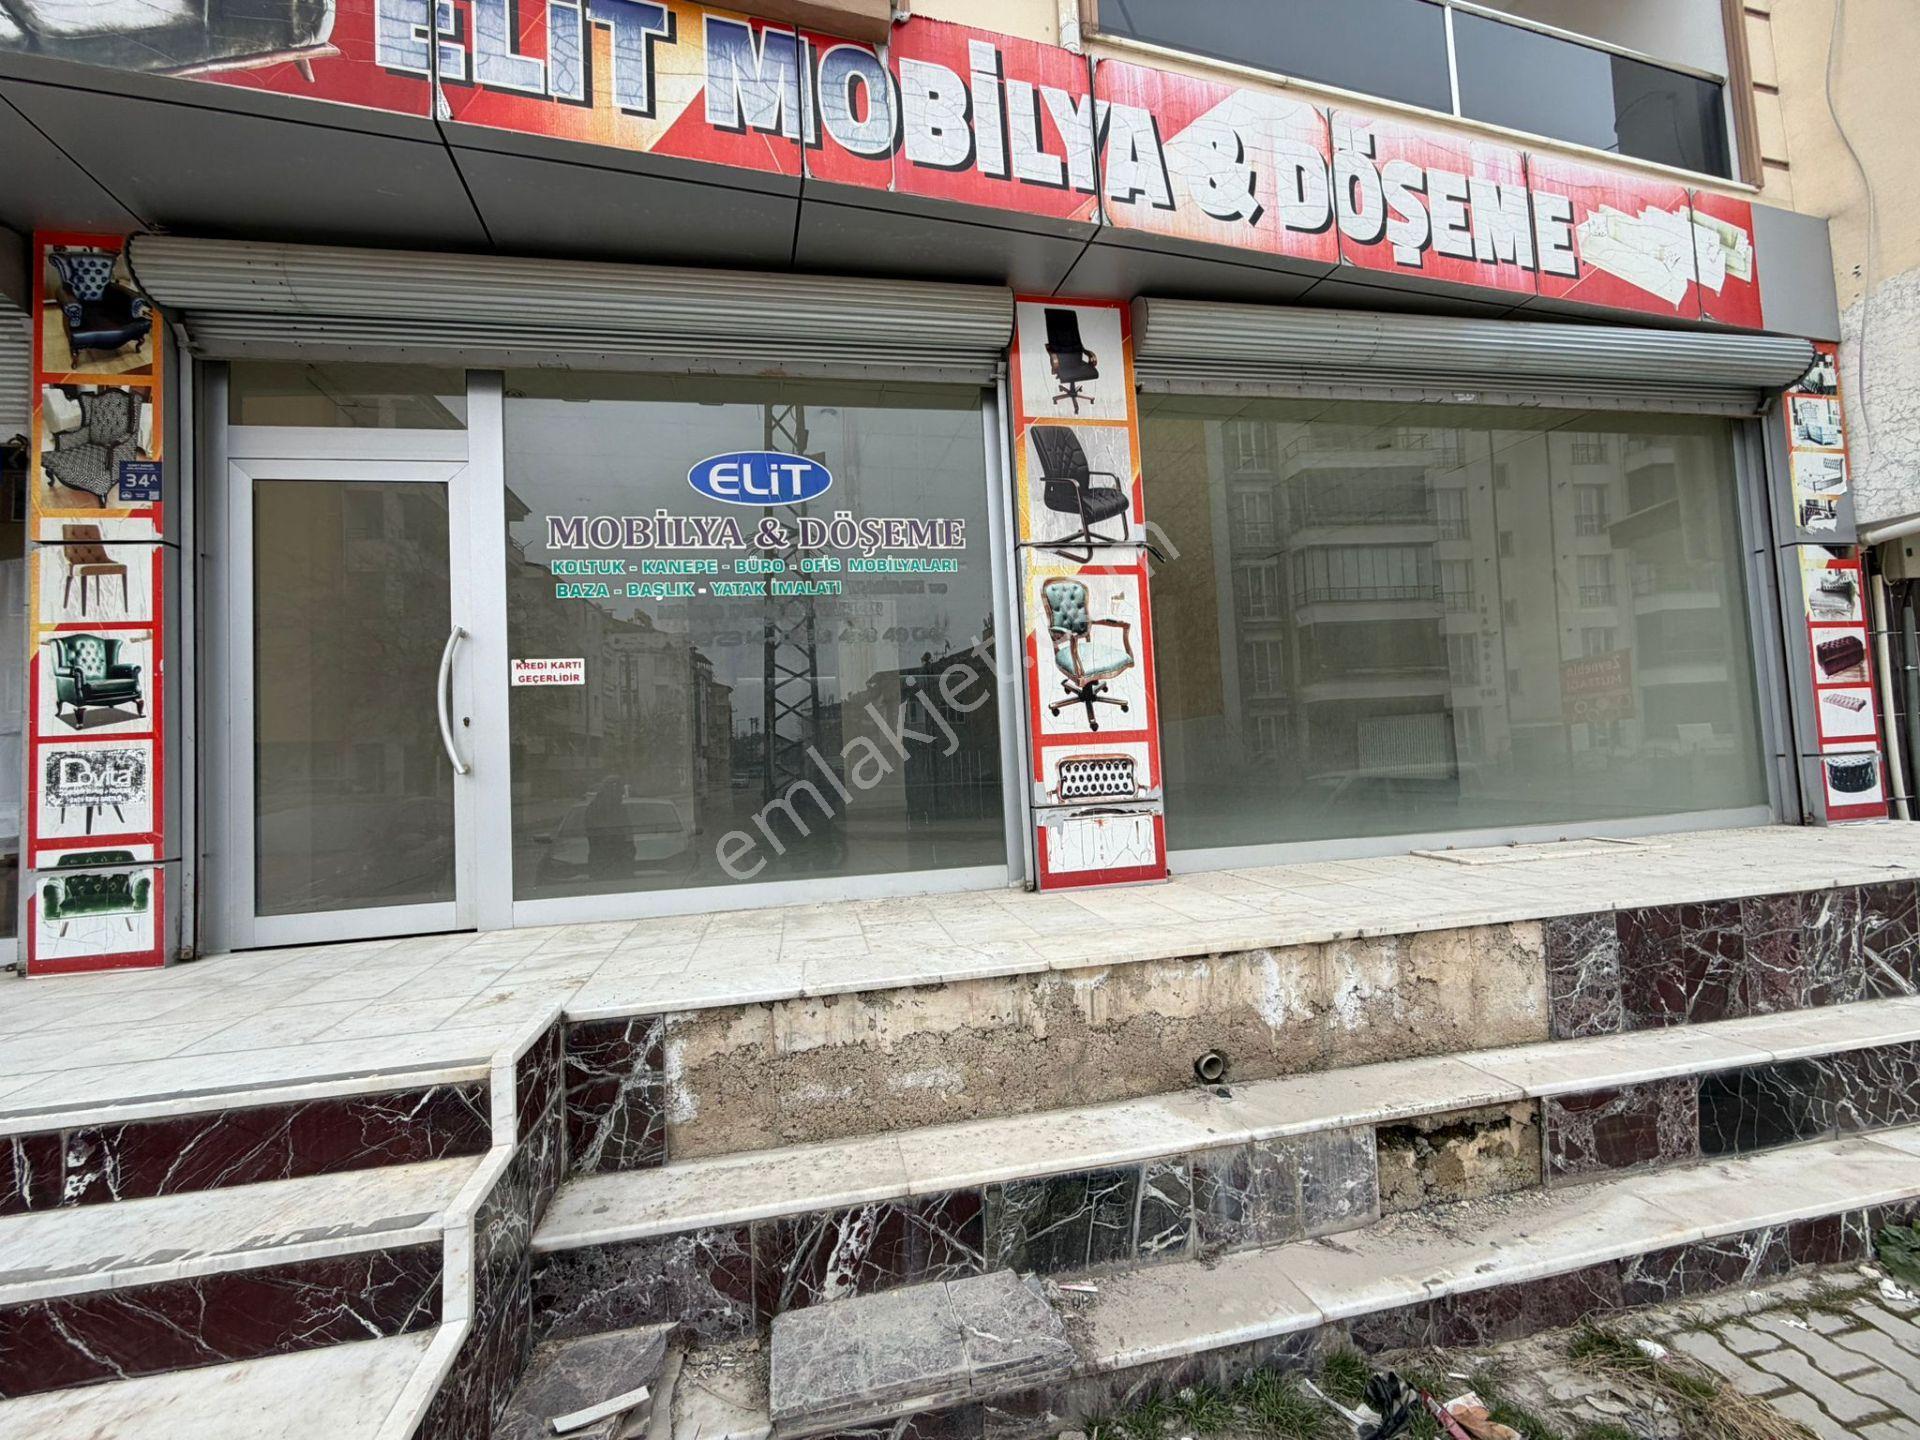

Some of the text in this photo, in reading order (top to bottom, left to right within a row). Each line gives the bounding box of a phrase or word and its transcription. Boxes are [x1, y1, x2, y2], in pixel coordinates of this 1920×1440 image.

[702, 11, 1175, 210] MOBİLYA
[1188, 126, 1265, 227] &
[1274, 120, 1580, 279] DÖŞEME
[546, 509, 966, 557] MOBİLYA & DÖŞEME
[551, 559, 626, 575] KOLTUK
[642, 558, 718, 574] KANEPE
[735, 556, 785, 574] BÜRO
[801, 555, 841, 573] OFİS
[848, 555, 958, 573] MOBİLYALARI
[556, 582, 609, 599] BAZA
[626, 581, 695, 601] BAŞLIK
[709, 581, 767, 597] YATAK
[771, 579, 841, 595] İMALATI
[516, 661, 582, 670] KREDİ KARTI
[518, 672, 580, 683] GEÇERLİDİR
